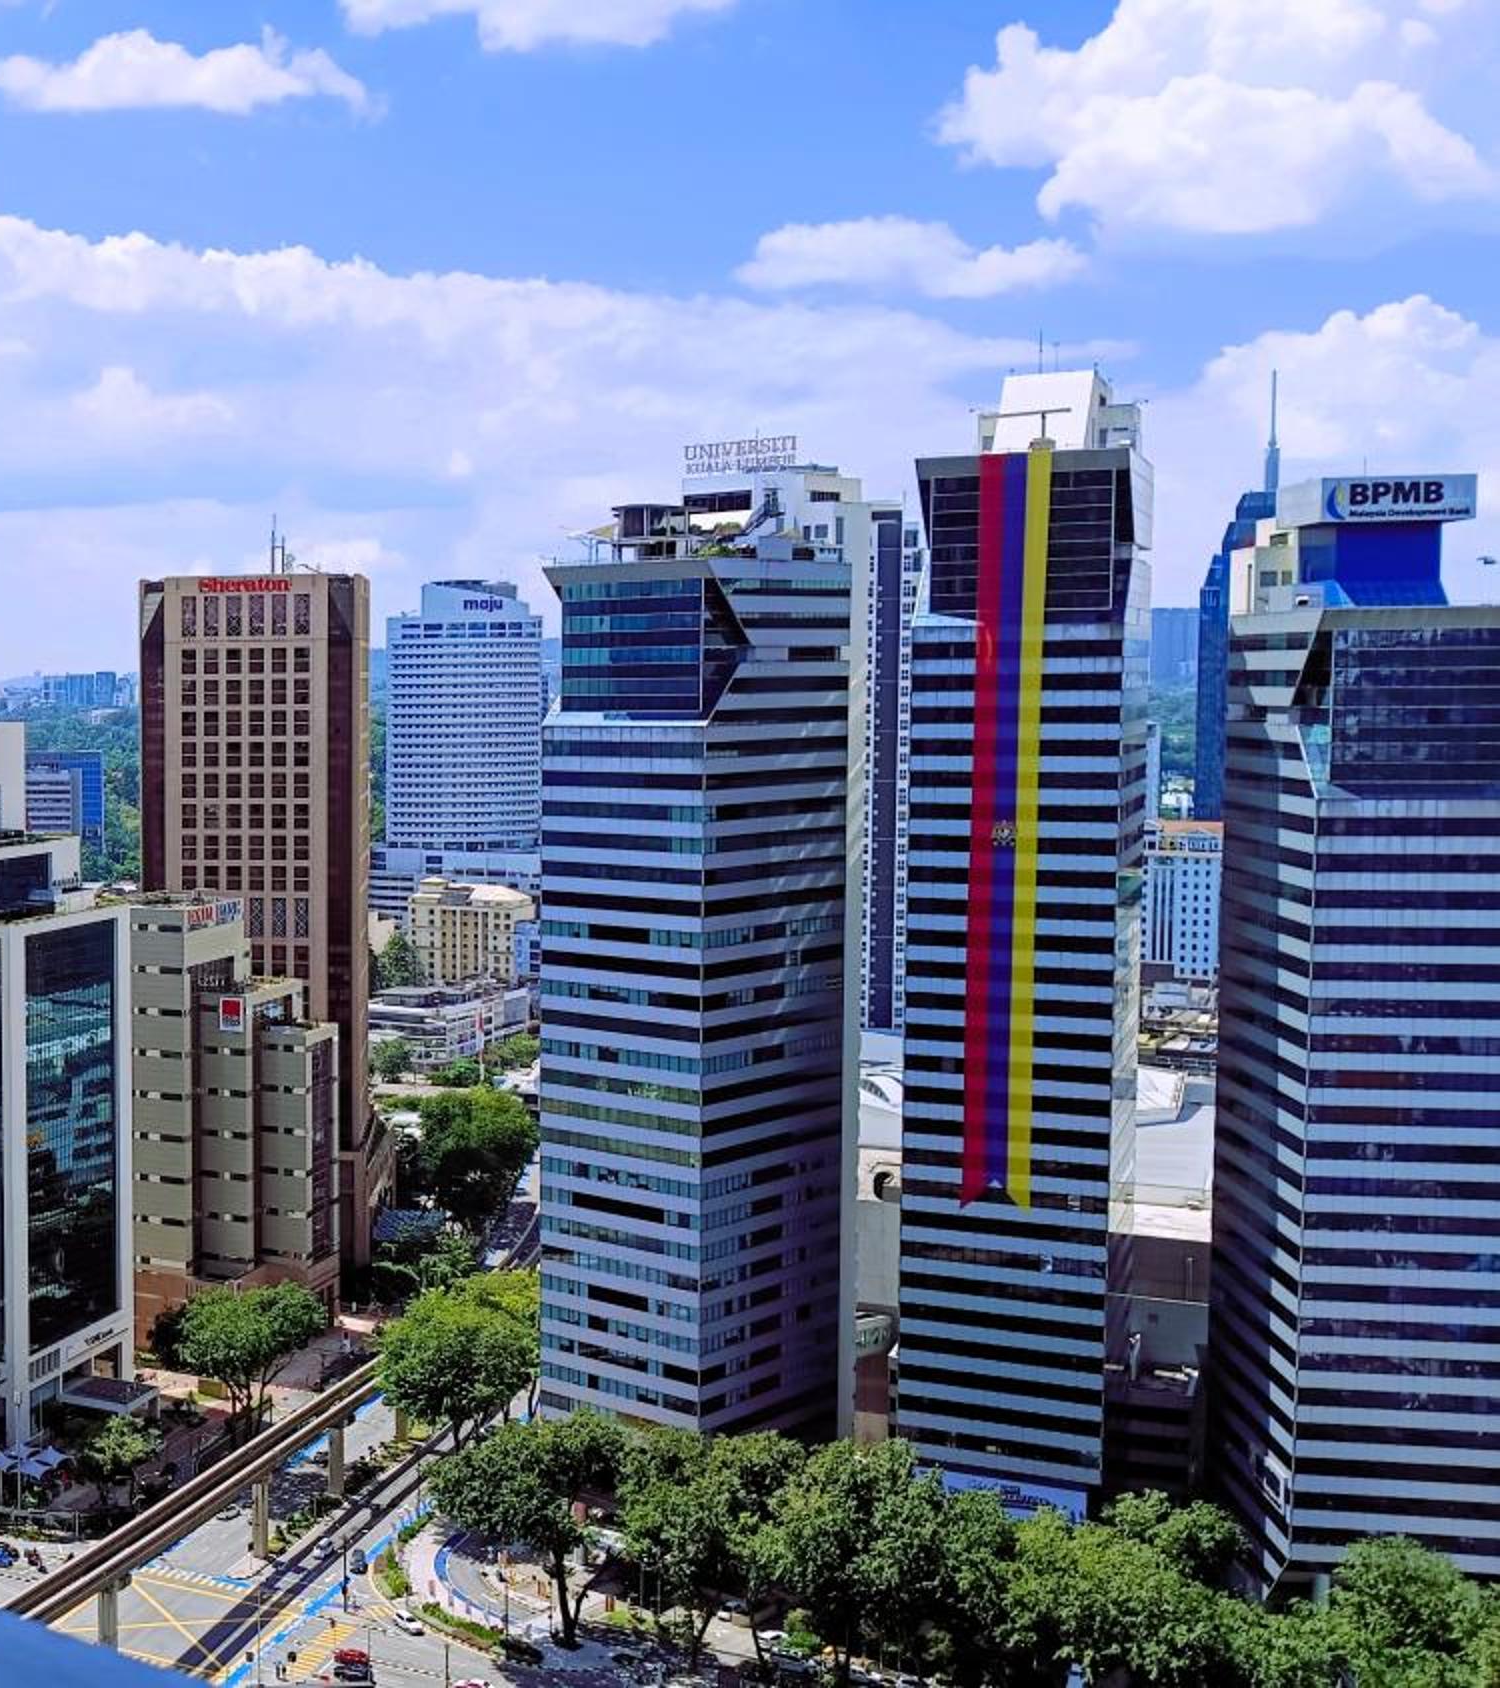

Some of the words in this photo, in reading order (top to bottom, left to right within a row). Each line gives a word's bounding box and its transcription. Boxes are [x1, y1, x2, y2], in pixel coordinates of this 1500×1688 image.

[684, 436, 797, 460] UNIVERSITI
[1349, 481, 1445, 506] BPMB
[197, 577, 290, 593] Sheraton
[464, 596, 503, 613] maju
